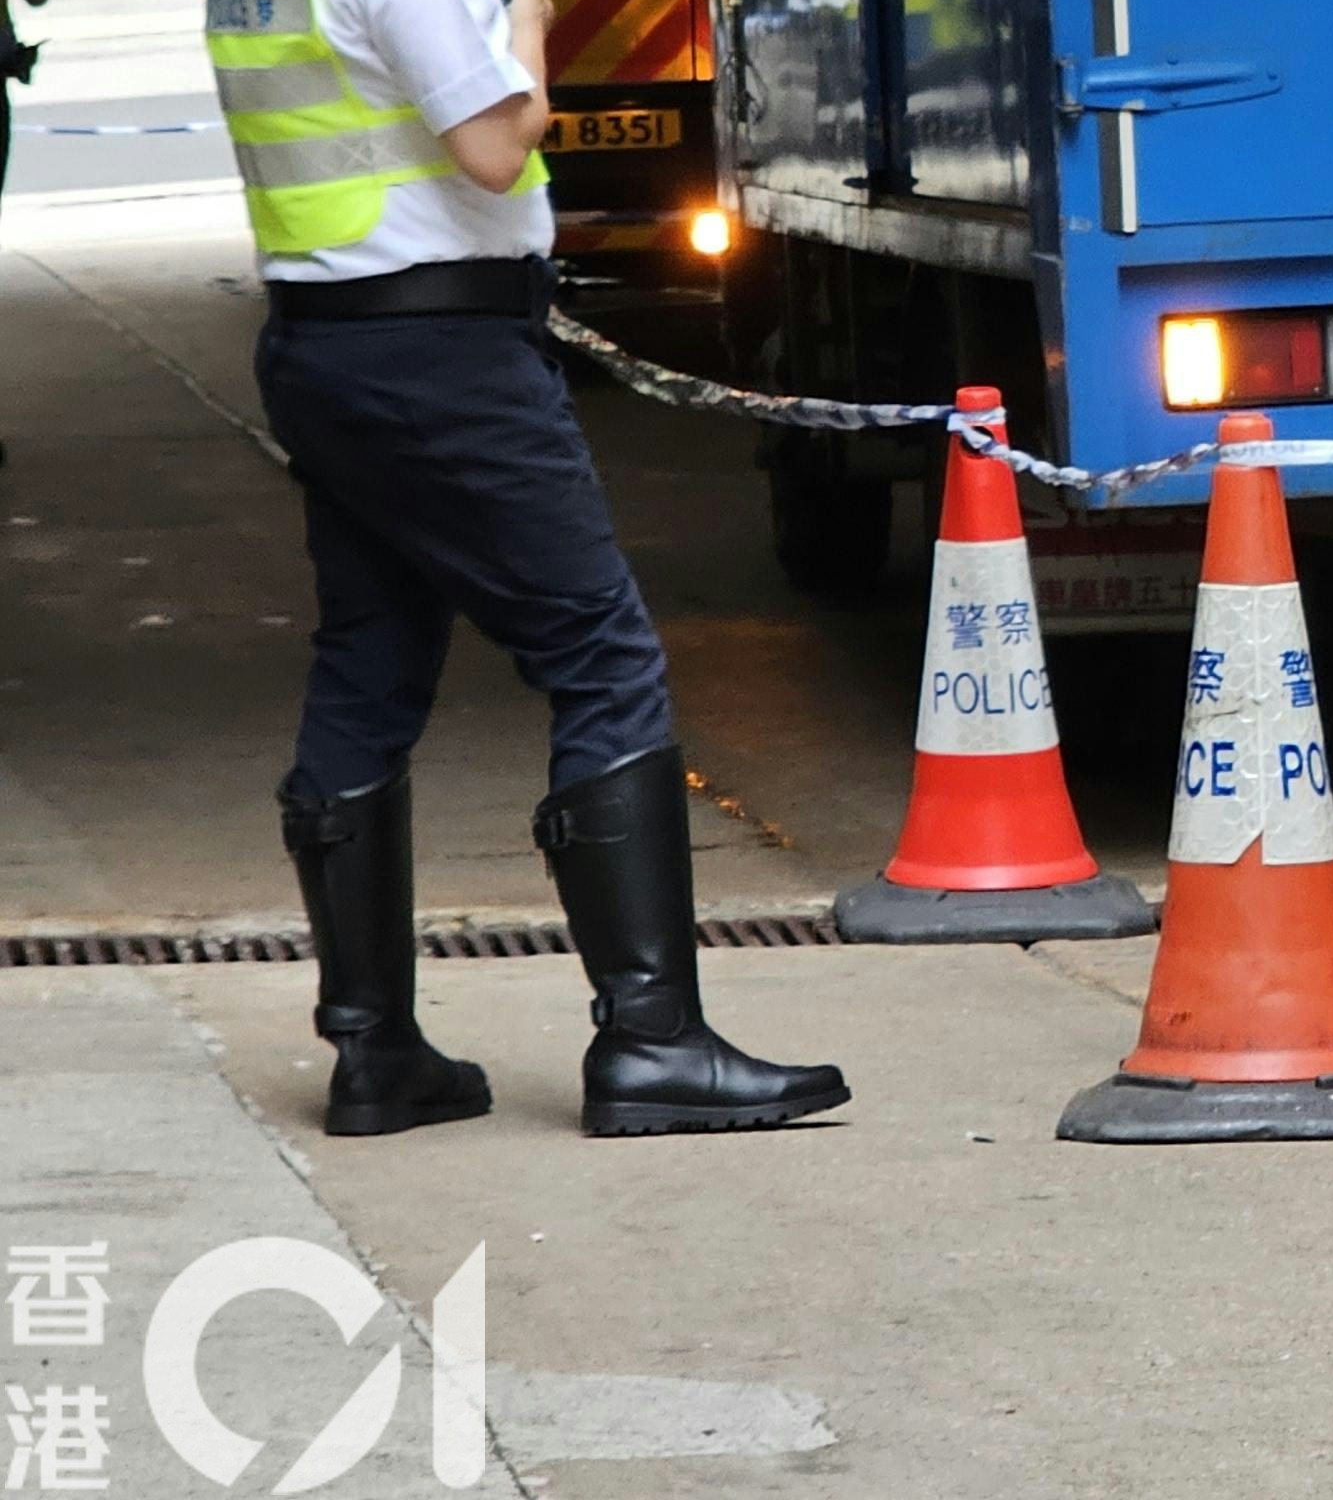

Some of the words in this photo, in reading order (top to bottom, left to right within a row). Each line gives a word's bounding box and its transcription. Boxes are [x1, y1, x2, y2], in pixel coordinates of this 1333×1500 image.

[578, 113, 664, 146] 8351
[946, 598, 1032, 651] 警察
[934, 668, 1052, 714] POLICE
